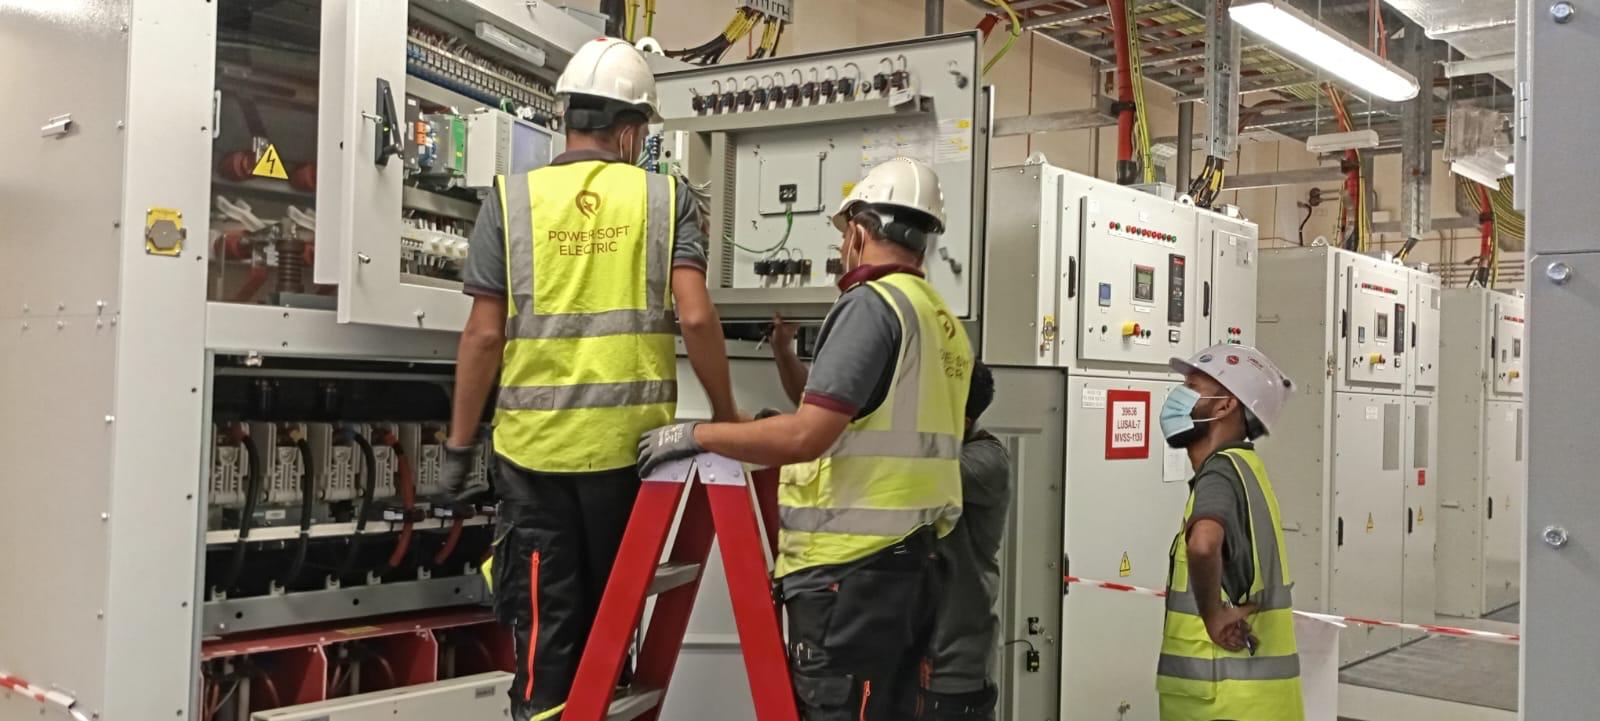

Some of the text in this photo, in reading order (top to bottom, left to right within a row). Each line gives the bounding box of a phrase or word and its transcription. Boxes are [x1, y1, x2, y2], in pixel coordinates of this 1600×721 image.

[548, 225, 630, 242] POWER SOFT
[559, 241, 618, 256] ELECTRIC
